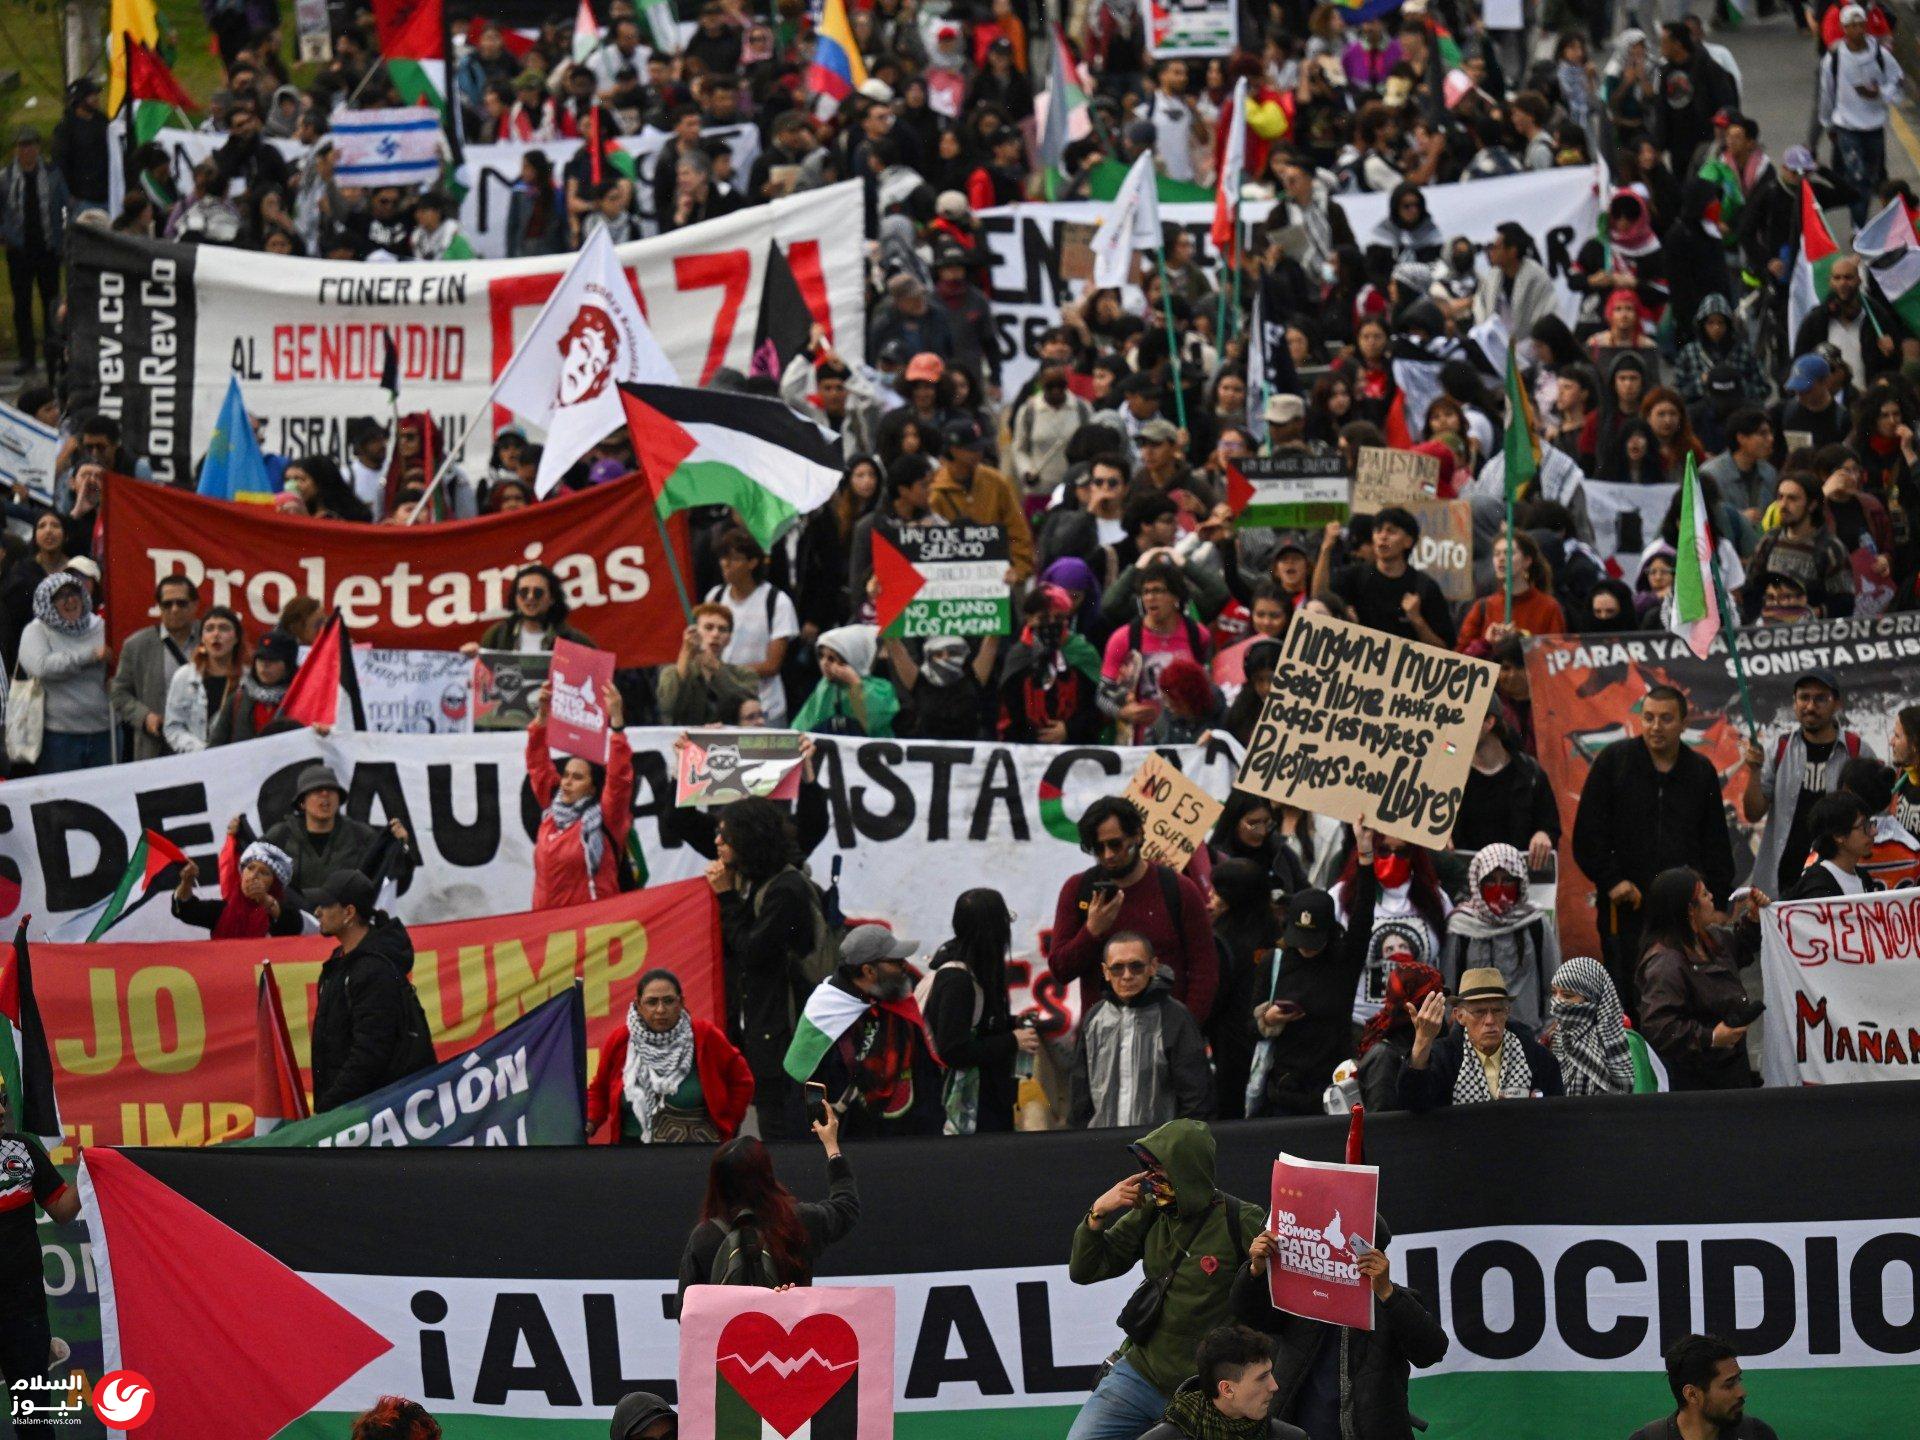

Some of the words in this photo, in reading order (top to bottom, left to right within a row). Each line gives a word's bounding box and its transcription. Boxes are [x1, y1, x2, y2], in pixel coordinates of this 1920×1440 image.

[420, 273, 467, 305] FIN
[231, 336, 263, 381] AL
[273, 323, 465, 383] GENOCDIO
[1407, 536, 1467, 570] LDITO
[904, 617, 941, 637] LOS
[1547, 641, 1648, 675] ¡PARAR
[1650, 637, 1690, 660] YA
[1734, 617, 1870, 652] AGRESIÓN
[1390, 643, 1490, 703] mujer
[1725, 645, 1844, 679] SIONISTA
[1856, 641, 1892, 662] DE
[1261, 692, 1328, 734] Todas
[1323, 670, 1385, 717] libre
[1141, 774, 1172, 803] NO
[1171, 793, 1204, 825] ES
[1376, 756, 1462, 836] Libres
[0, 780, 222, 918] DE
[808, 737, 1032, 850] ASTA
[254, 917, 648, 1070] TUMP
[308, 1044, 531, 1148] PACIÓN
[1278, 1209, 1297, 1226] NO
[1278, 1222, 1322, 1242] SOMOS
[1278, 1235, 1331, 1260] PATIO
[1280, 1251, 1362, 1281] TRASERO
[410, 1289, 682, 1407] ¡AL
[904, 1280, 1105, 1399] AL
